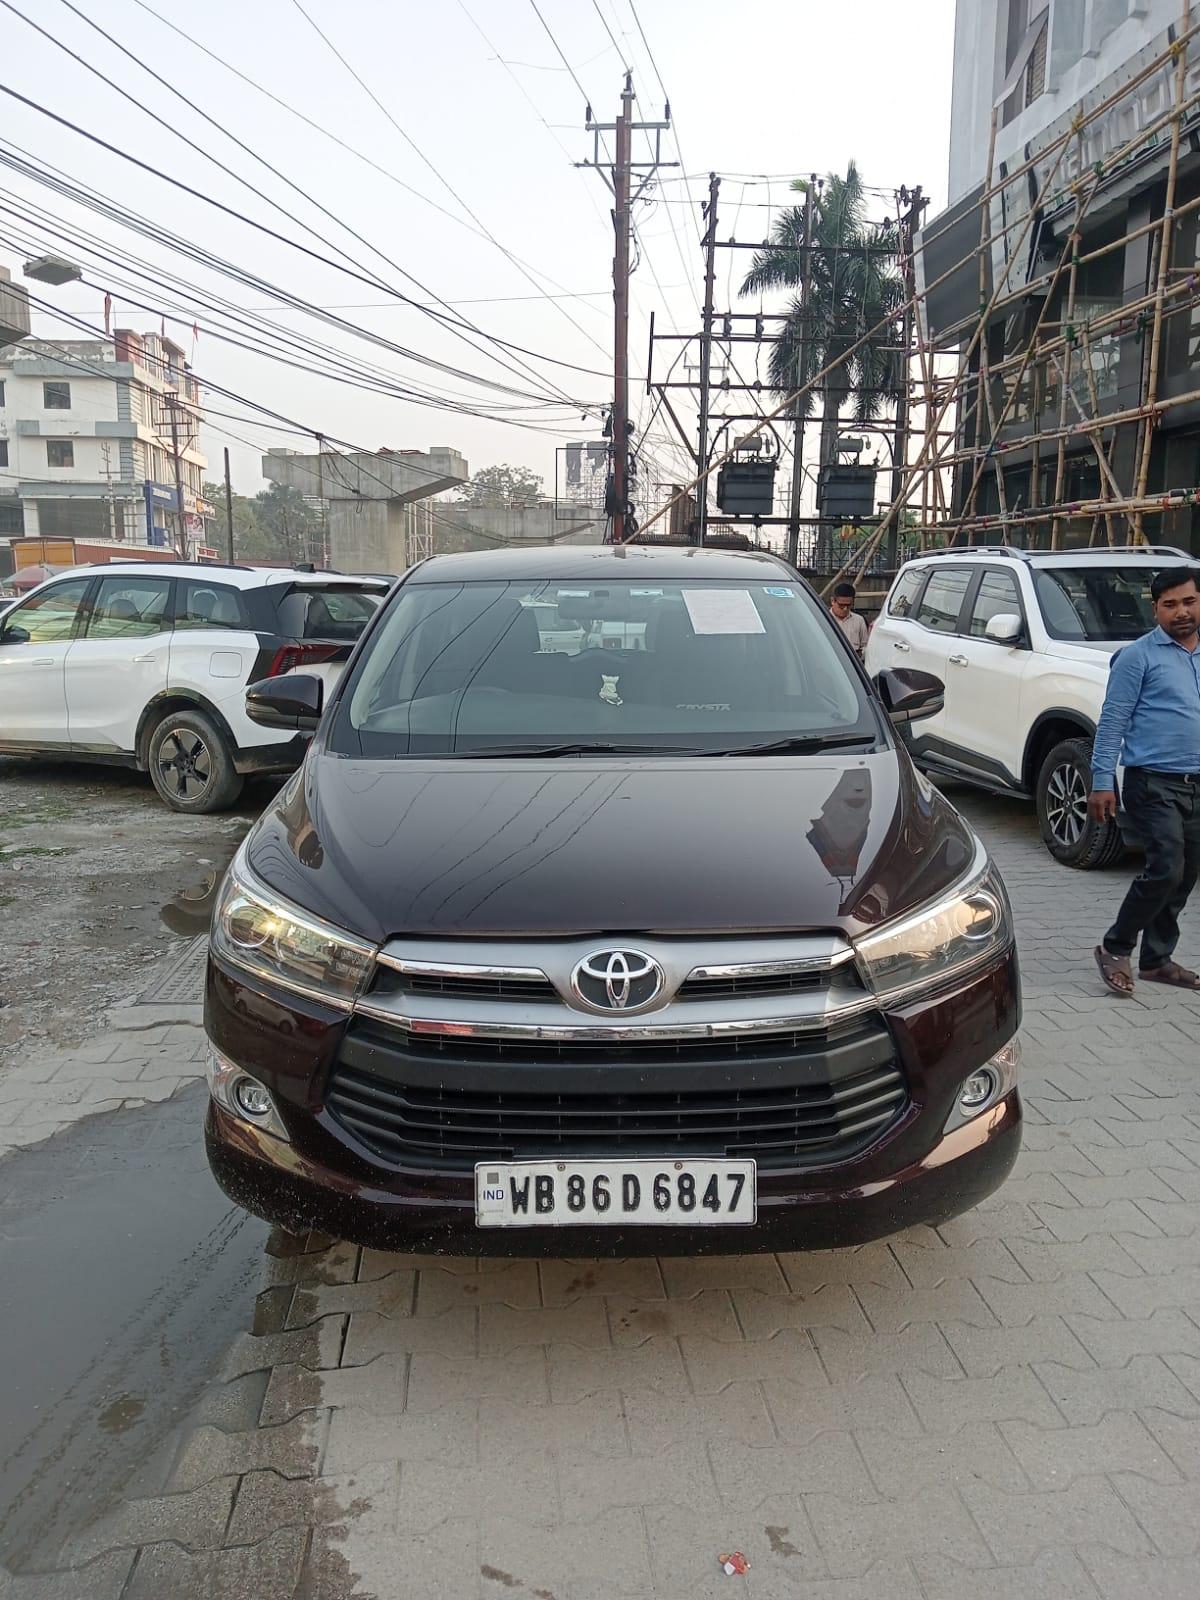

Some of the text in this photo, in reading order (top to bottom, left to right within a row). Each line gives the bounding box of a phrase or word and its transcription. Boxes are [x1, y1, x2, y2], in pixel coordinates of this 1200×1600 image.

[483, 1189, 504, 1201] IND
[509, 1172, 746, 1215] WB 86 D 6847
